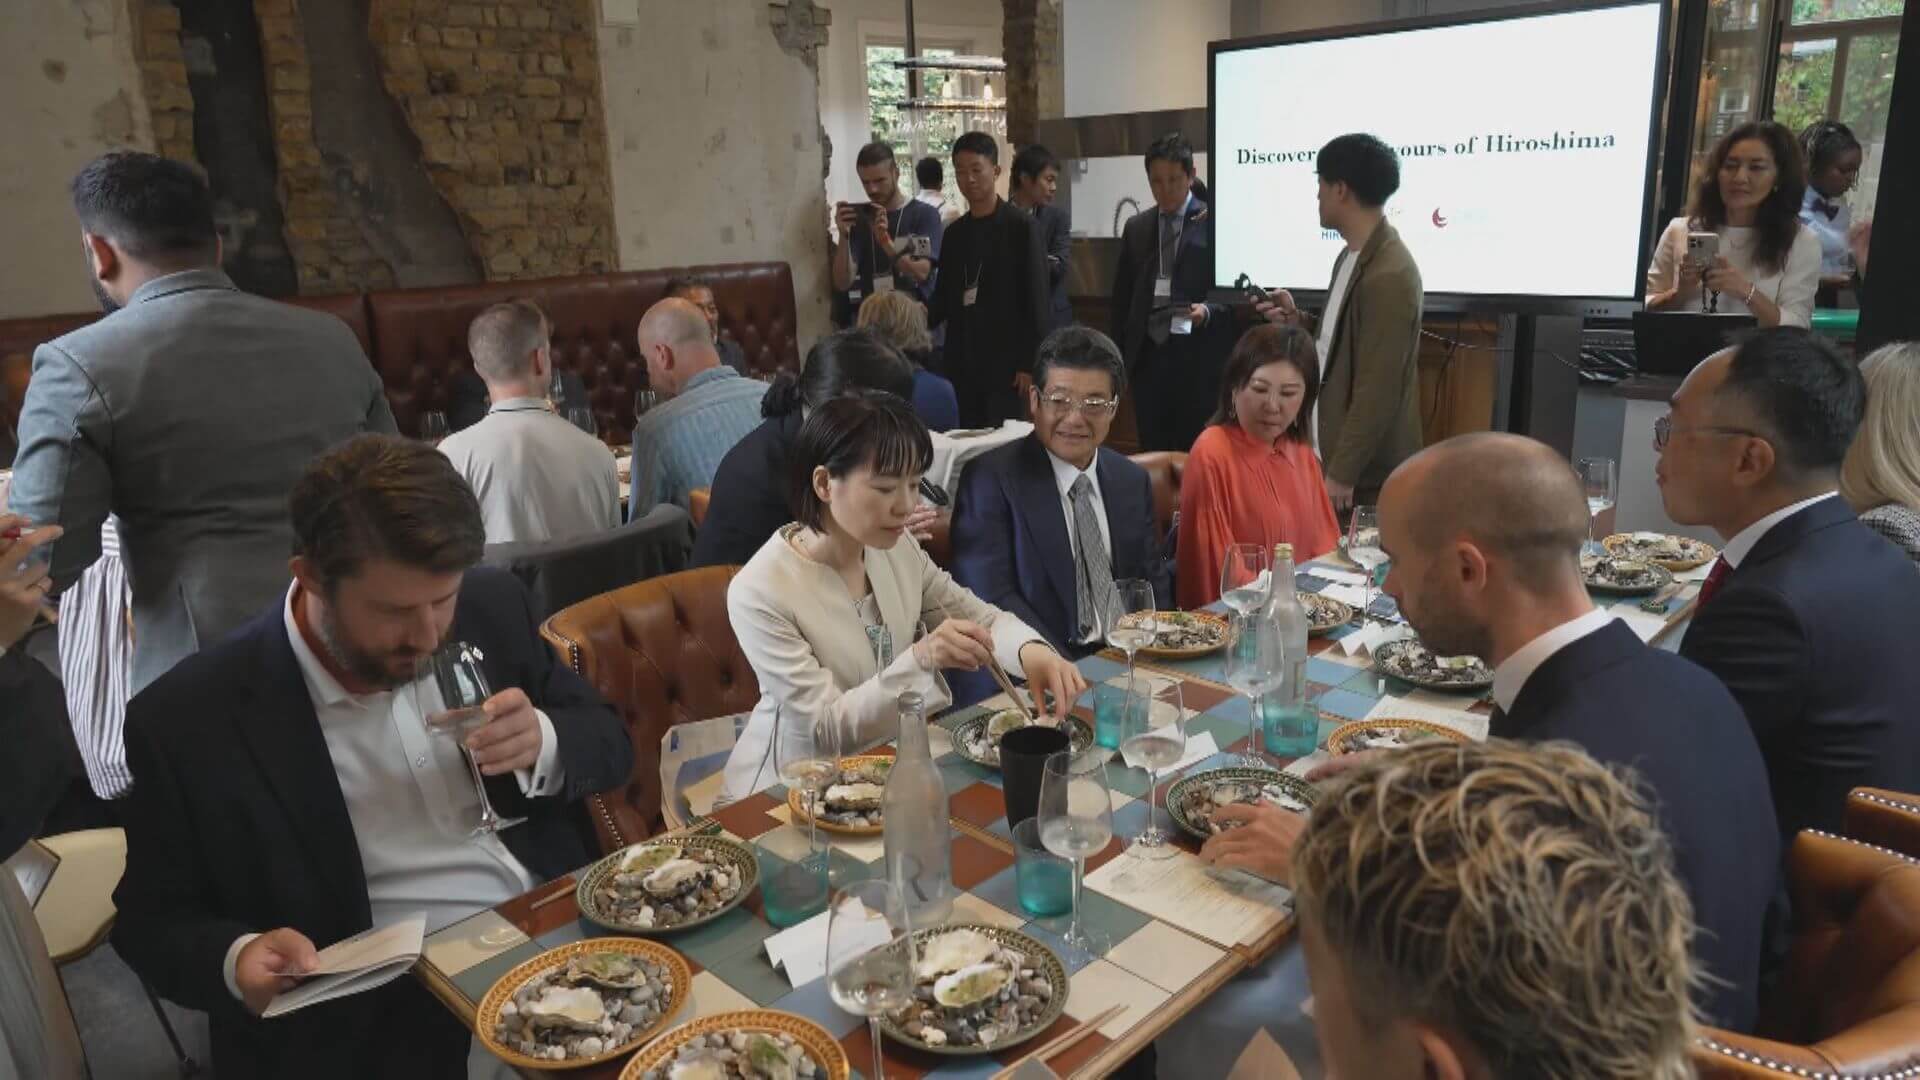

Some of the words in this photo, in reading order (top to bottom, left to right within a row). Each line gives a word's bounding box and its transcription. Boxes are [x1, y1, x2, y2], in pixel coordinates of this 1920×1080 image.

[1237, 147, 1317, 165] Discover
[1454, 135, 1479, 154] of
[1486, 130, 1615, 153] Hiroshima
